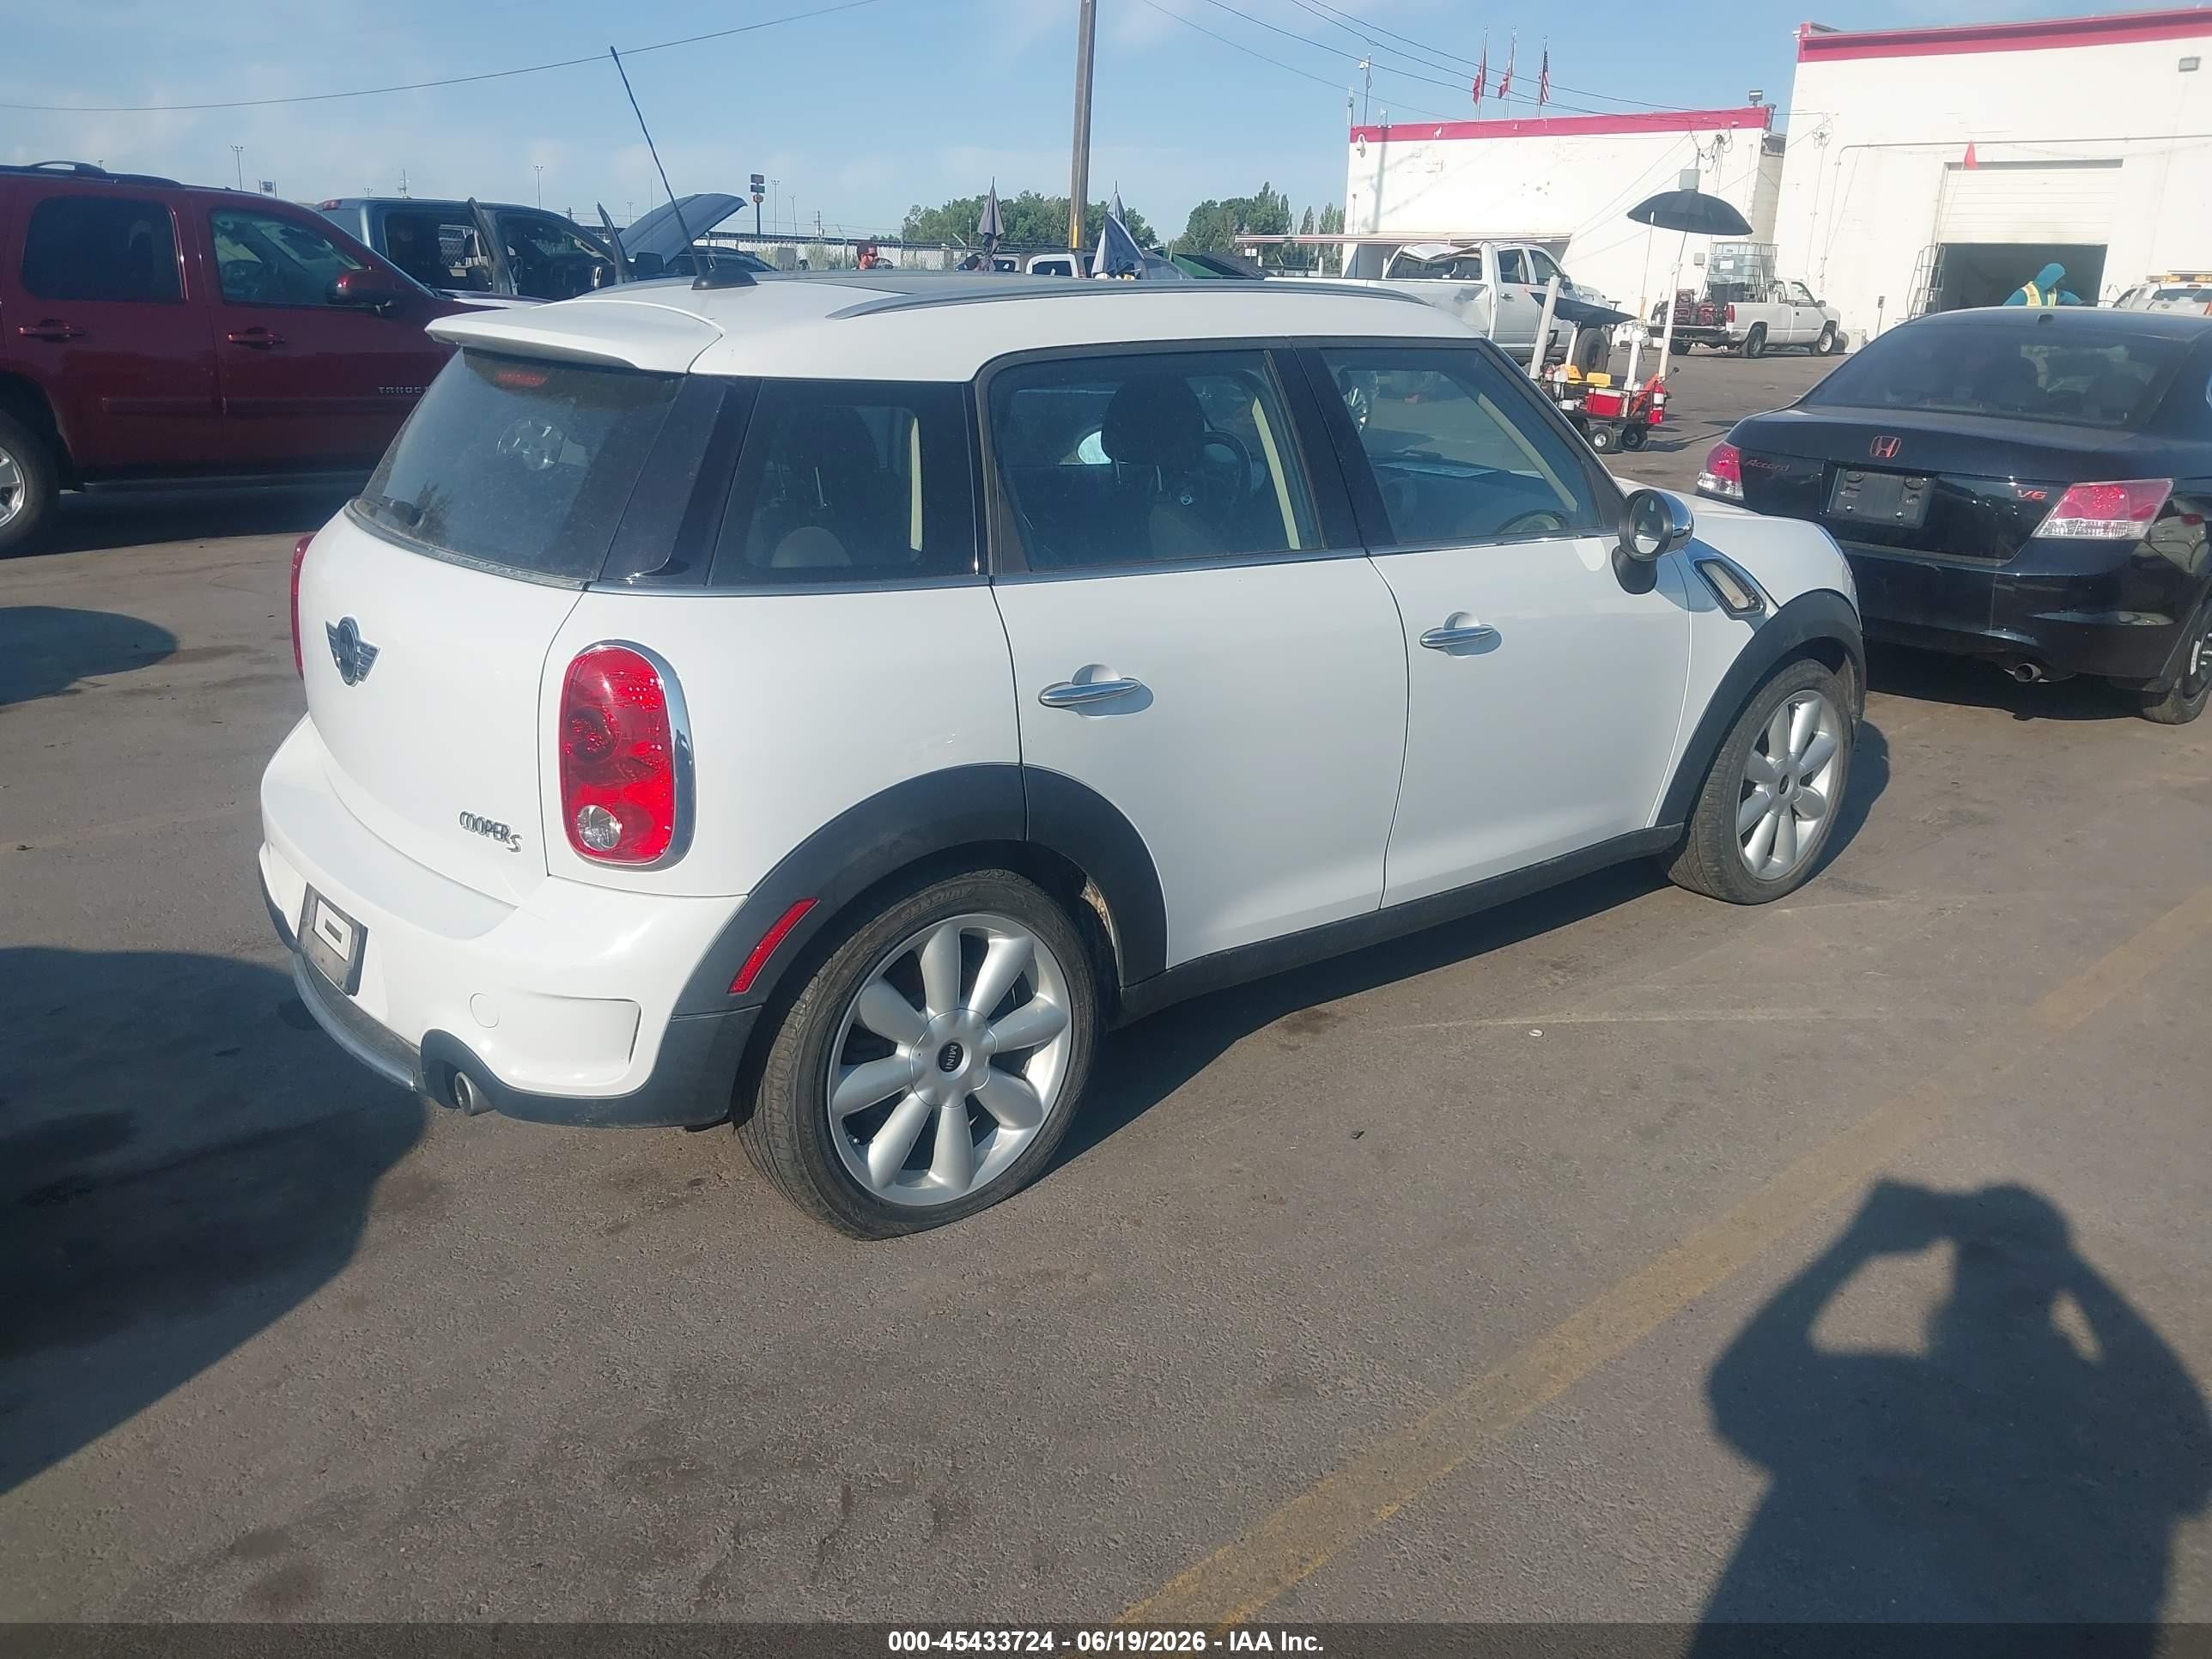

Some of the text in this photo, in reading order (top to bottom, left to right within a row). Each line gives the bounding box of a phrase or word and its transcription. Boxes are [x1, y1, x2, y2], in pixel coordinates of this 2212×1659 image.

[2017, 489, 2048, 500] V6
[459, 810, 512, 845] COOPER
[945, 1044, 958, 1070] MINI
